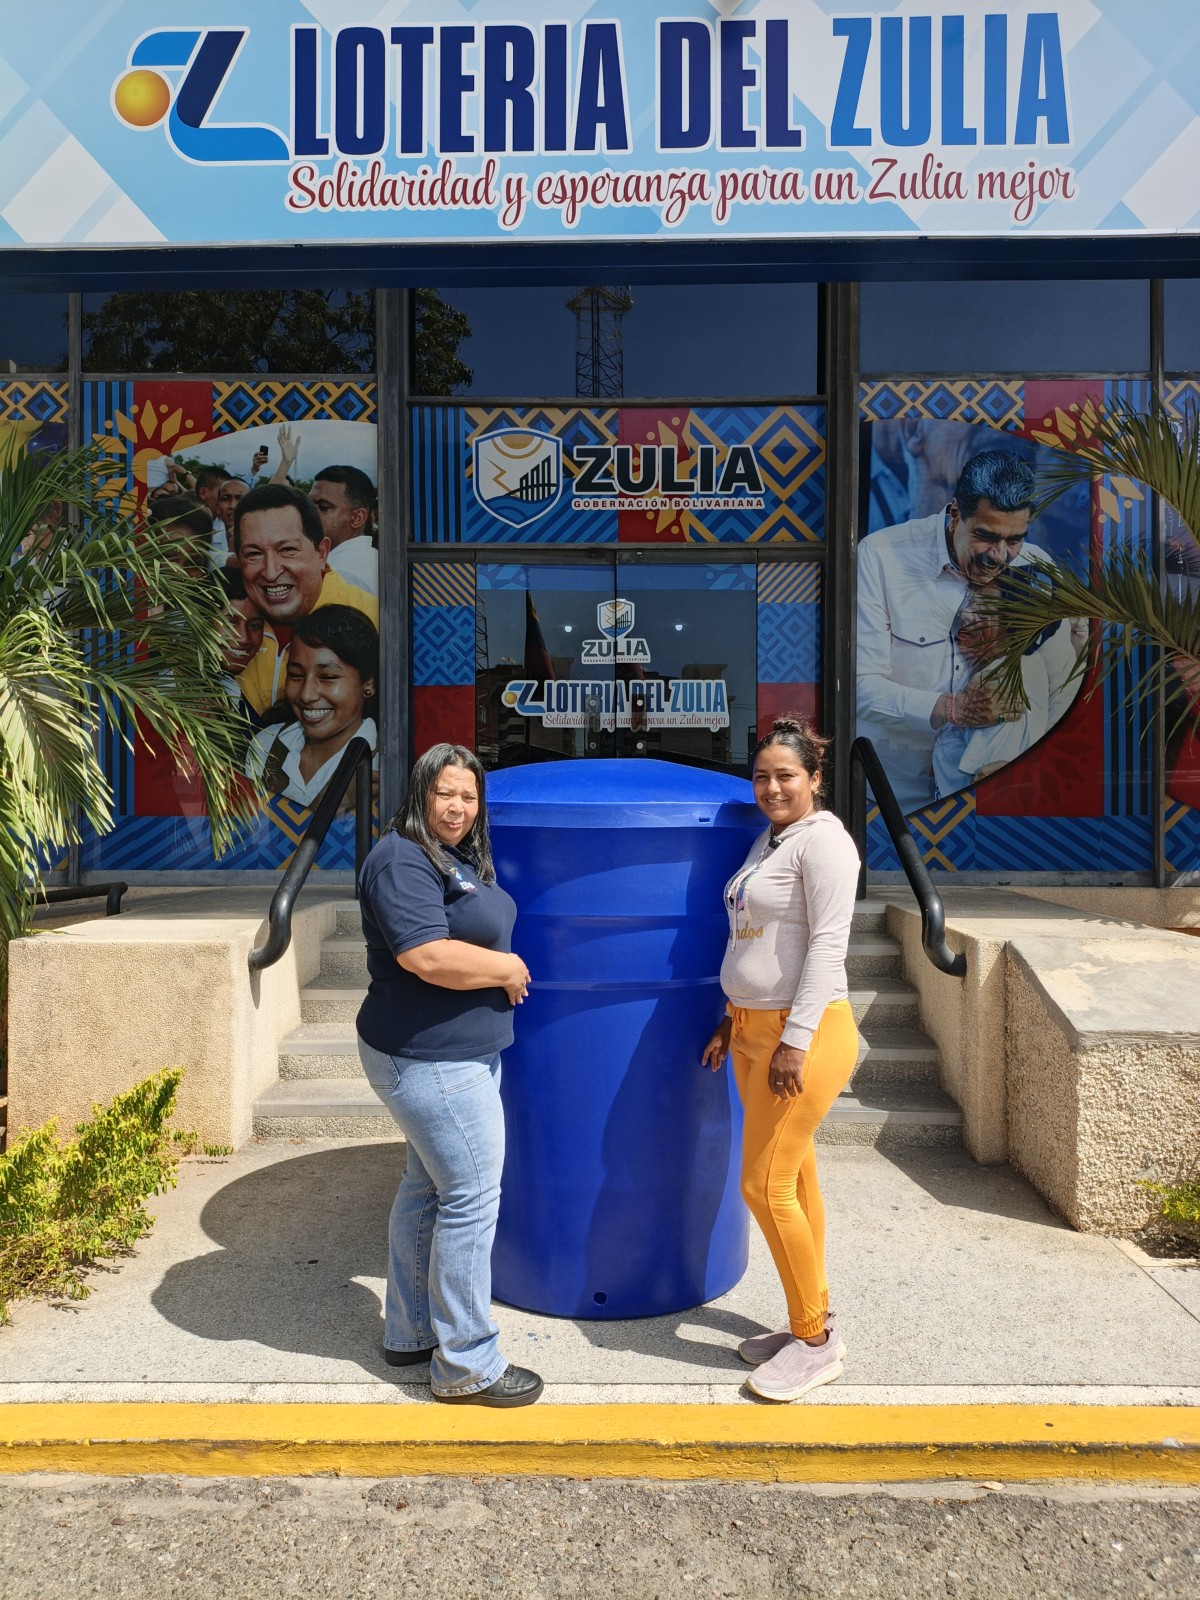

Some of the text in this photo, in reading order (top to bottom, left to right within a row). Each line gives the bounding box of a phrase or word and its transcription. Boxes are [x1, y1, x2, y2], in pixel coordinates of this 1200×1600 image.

[294, 12, 1070, 156] LOTERIA DEL ZULIA
[288, 153, 1076, 227] Solidaridad y esperanza para un Zulia mejor
[574, 447, 764, 492] ZULIA
[573, 497, 763, 509] GOBERNACIÓN BOLIVARIANA
[583, 640, 648, 658] ZULIA
[546, 682, 726, 713] LOTERIA DEL ZULIA
[666, 717, 678, 725] un
[680, 713, 703, 725] Zulia
[703, 714, 727, 730] mejor
